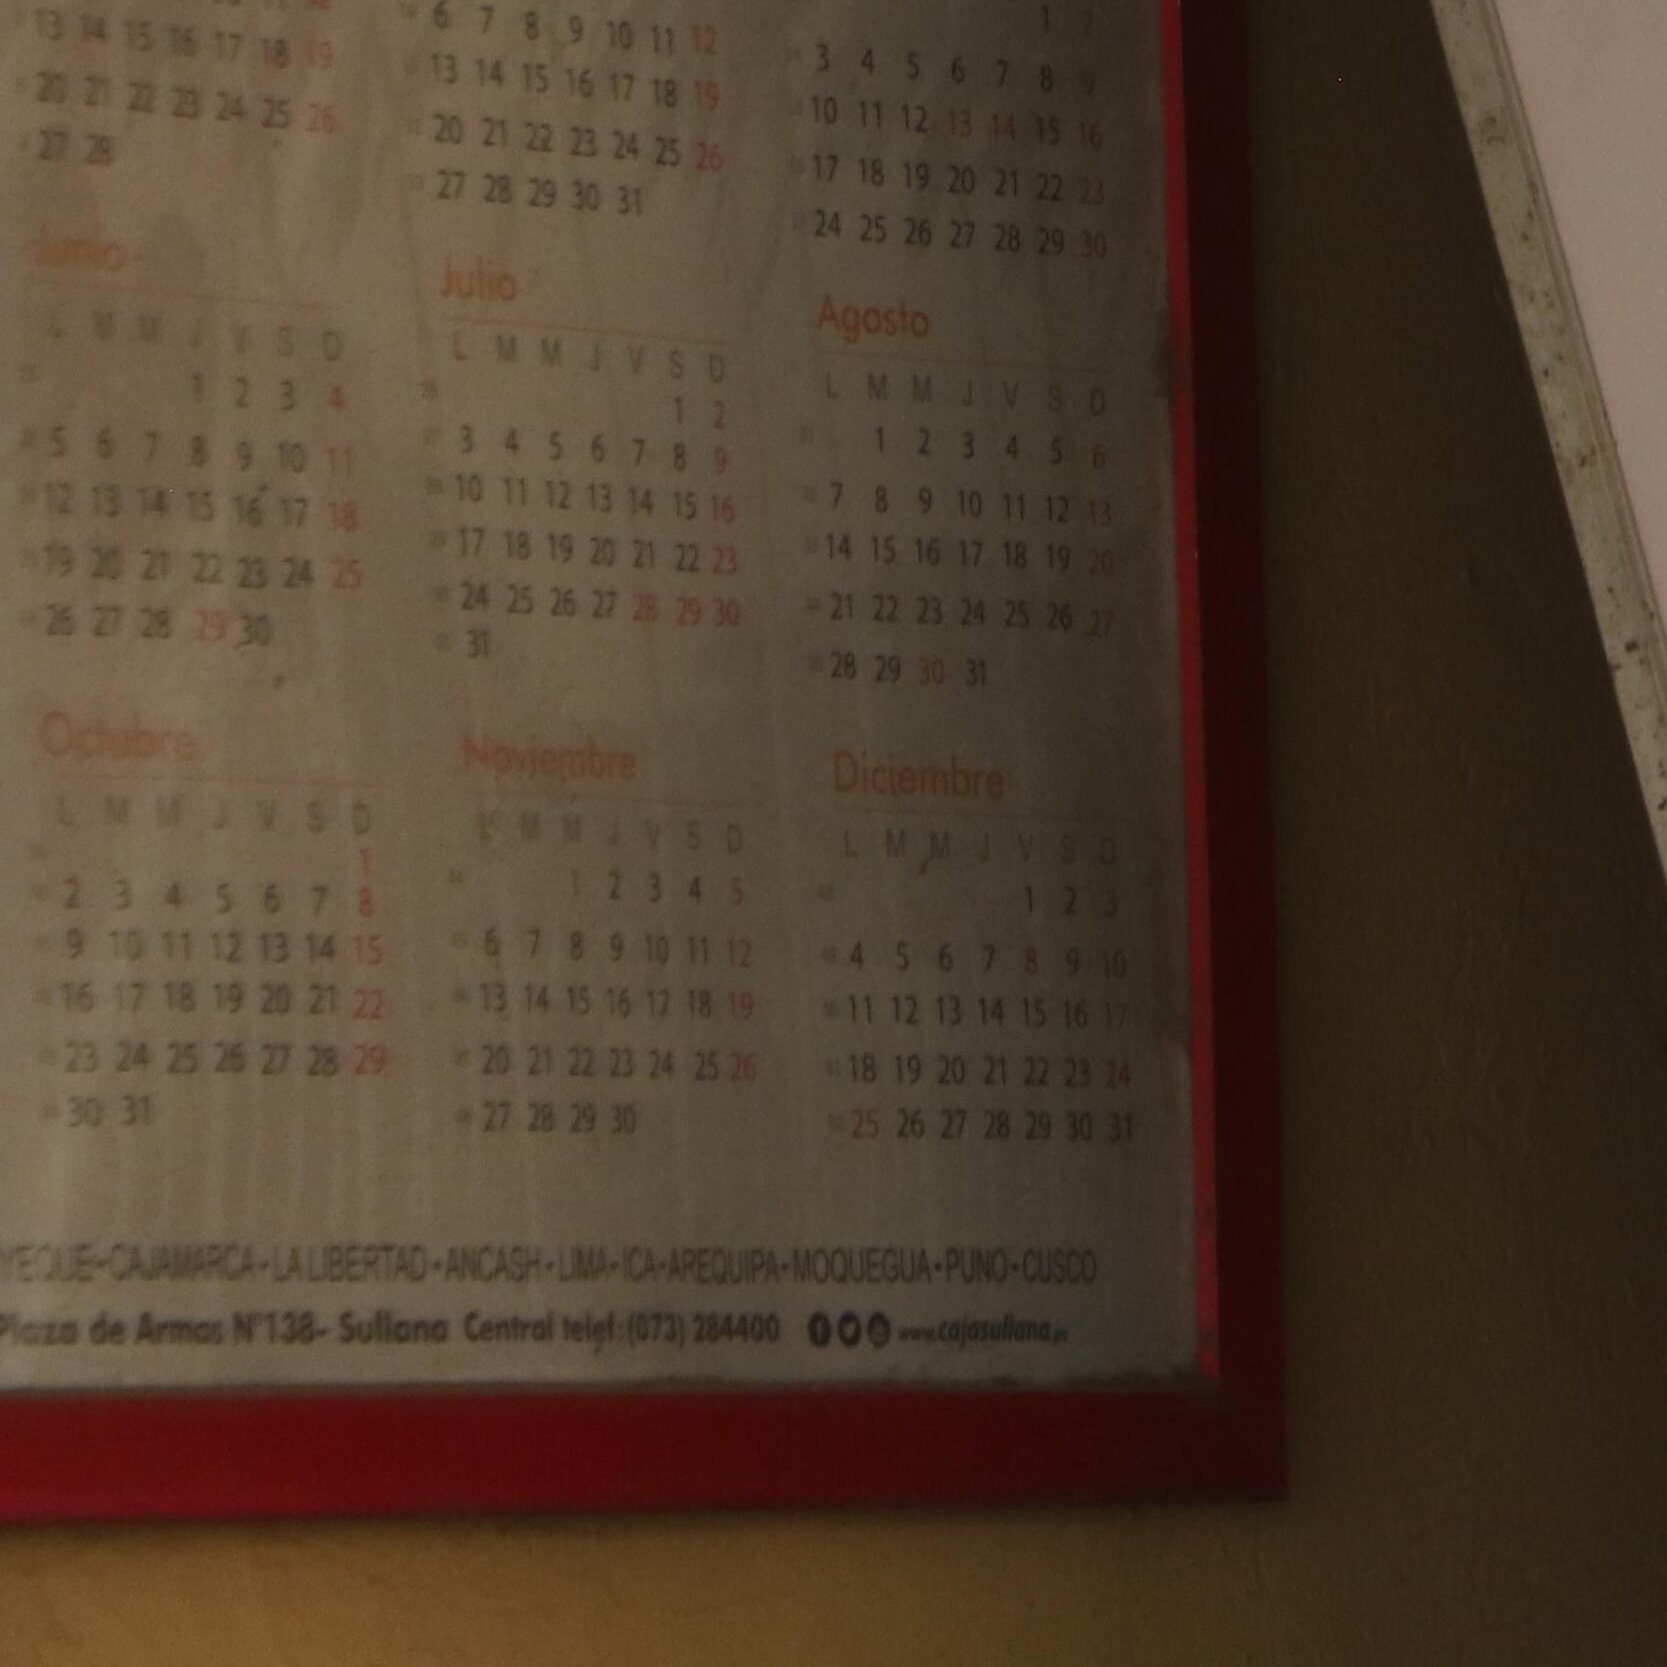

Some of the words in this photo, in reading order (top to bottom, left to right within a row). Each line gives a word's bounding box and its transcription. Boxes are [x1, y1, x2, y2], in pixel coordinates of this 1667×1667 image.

[434, 113, 463, 144] 20
[480, 116, 508, 147] 21
[525, 122, 553, 152] 22
[568, 127, 598, 157] 23
[612, 130, 639, 160] 24
[655, 137, 681, 167] 25
[696, 142, 723, 172] 26
[813, 153, 839, 182] 17
[858, 158, 885, 186] 18
[904, 162, 929, 190] 19
[948, 166, 975, 194] 20
[994, 169, 1019, 197] 21
[1037, 173, 1063, 202] 22
[814, 210, 841, 238] 24
[860, 214, 887, 243] 25
[904, 218, 931, 246] 26
[949, 221, 975, 249] 27
[816, 293, 930, 344] Agosto
[456, 526, 486, 556] 17
[504, 531, 530, 559] 18
[549, 534, 574, 562] 19
[589, 537, 616, 567] 20
[632, 540, 656, 568] 21
[675, 543, 699, 572] 22
[712, 545, 738, 574] 23
[830, 592, 854, 621] 21
[872, 593, 899, 622] 22
[917, 596, 942, 625] 23
[959, 597, 985, 626] 24
[1004, 600, 1030, 628] 25
[1046, 602, 1072, 630] 26
[832, 749, 1007, 799] Diciembre
[64, 876, 81, 909] 2
[111, 879, 131, 911] 3
[216, 882, 232, 914] 5
[264, 883, 280, 914] 6
[311, 884, 329, 915] 7
[359, 885, 373, 917] 8
[484, 928, 499, 958] 6
[526, 929, 541, 958] 7
[569, 931, 584, 961] 8
[610, 933, 624, 963] 9
[645, 935, 669, 965] 10
[687, 936, 709, 965] 11
[728, 937, 751, 967] 12
[849, 1054, 877, 1082] 18
[895, 1054, 921, 1083] 19
[937, 1056, 966, 1085] 20
[983, 1056, 1007, 1086] 21
[1024, 1056, 1049, 1086] 22
[1064, 1058, 1091, 1088] 23
[1105, 1059, 1132, 1089] 24
